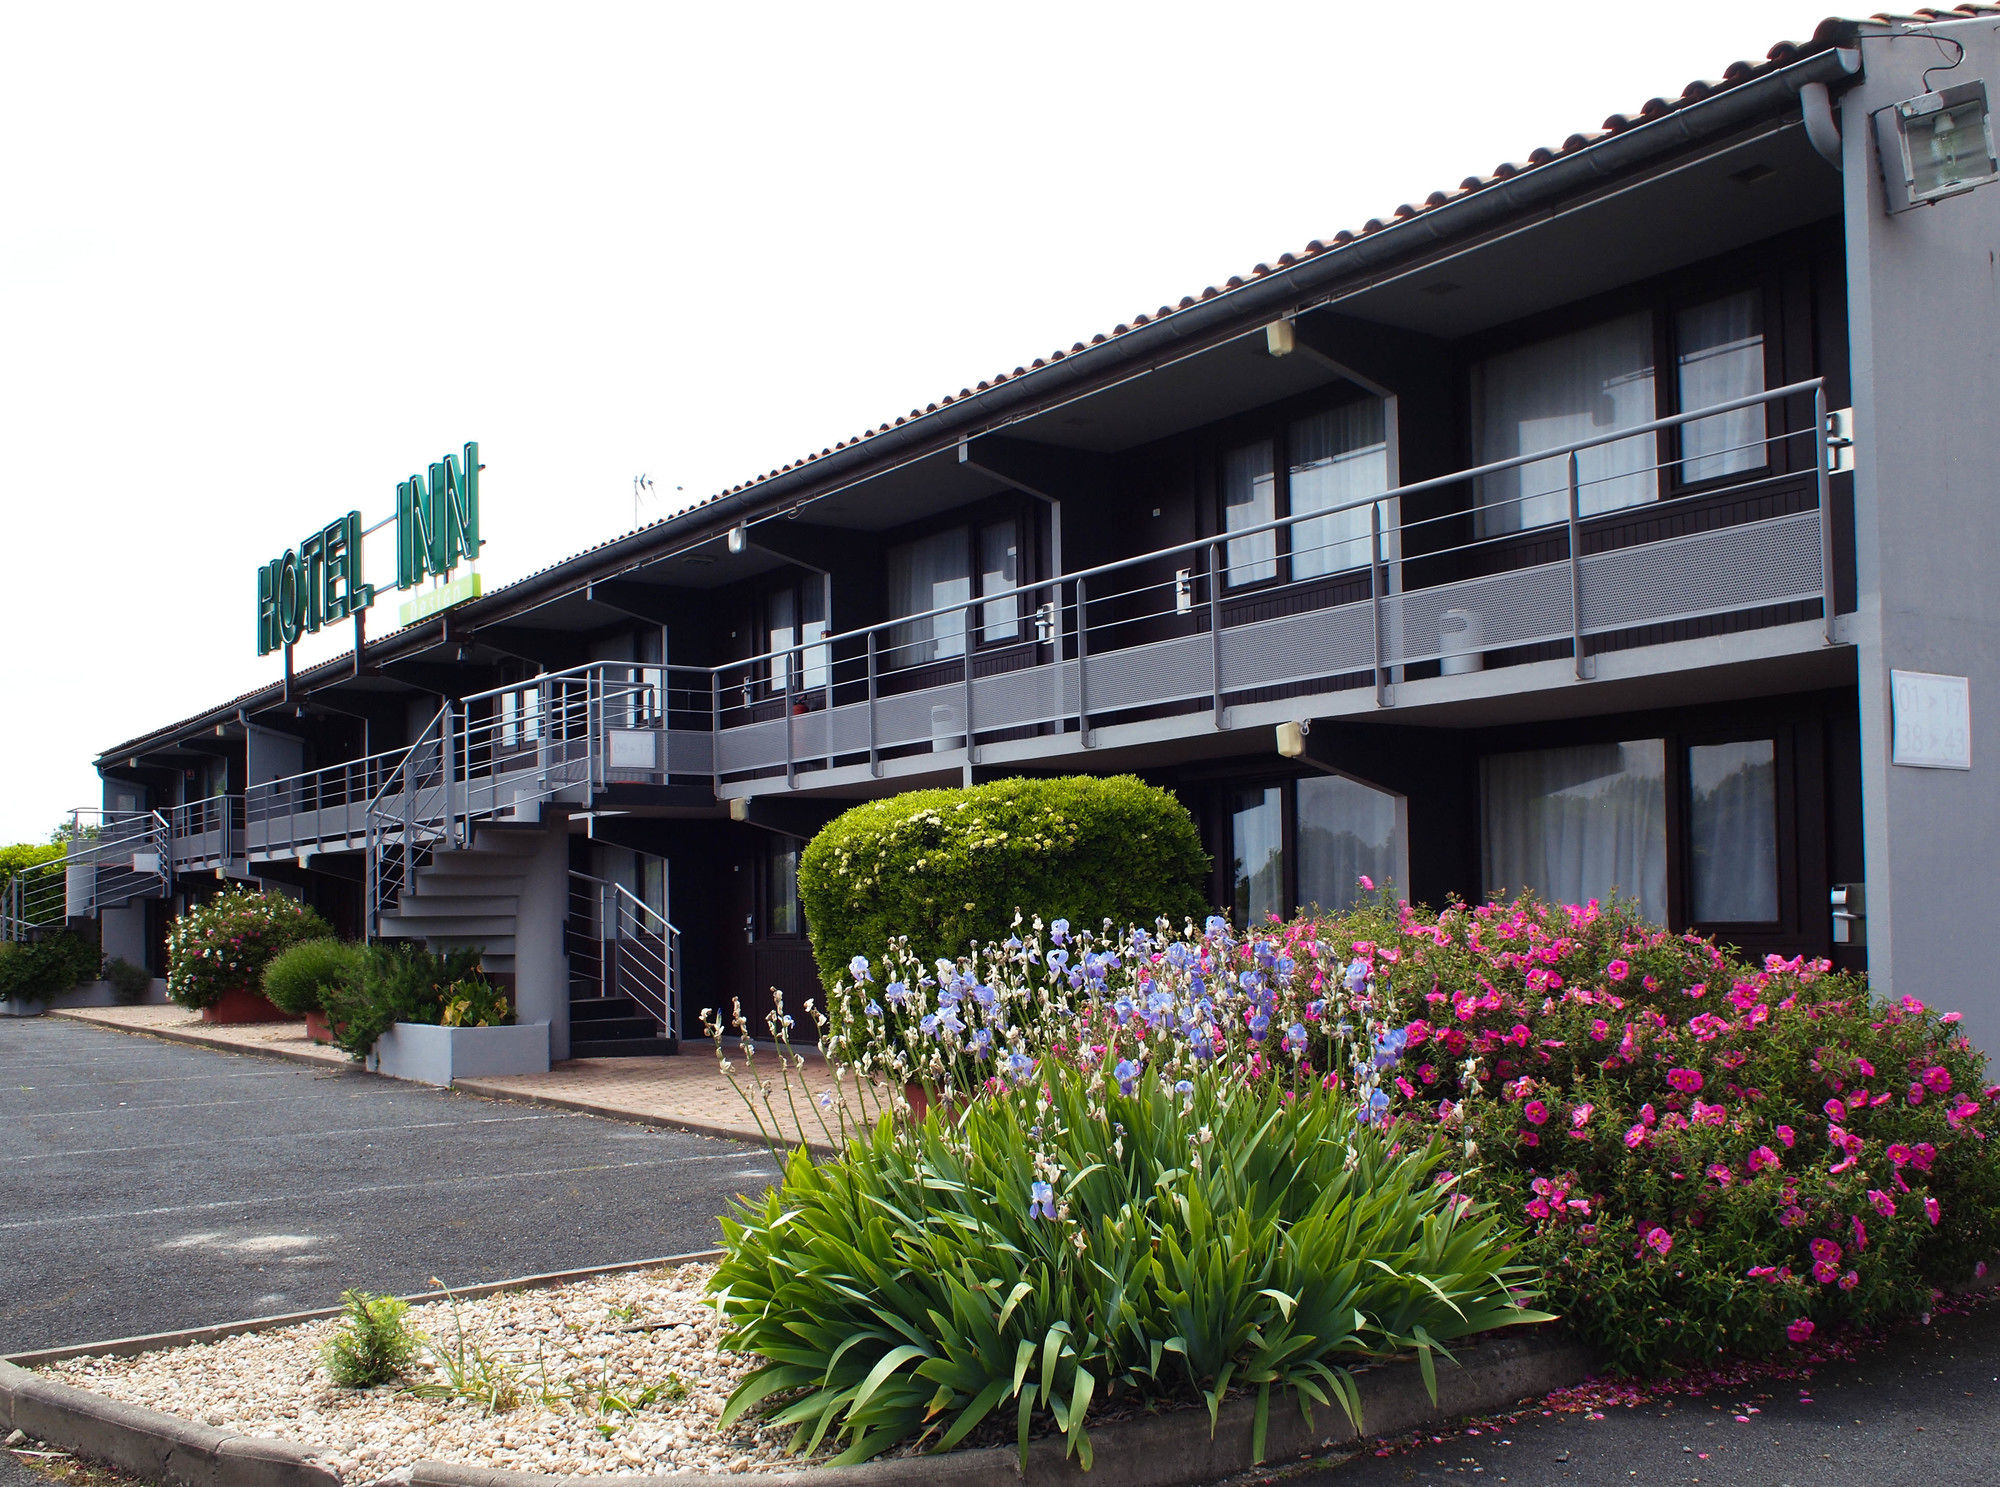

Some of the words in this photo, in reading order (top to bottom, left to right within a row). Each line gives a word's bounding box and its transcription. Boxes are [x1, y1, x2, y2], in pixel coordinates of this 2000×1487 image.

[258, 511, 374, 656] HOTEL
[397, 442, 478, 591] INN
[1899, 683, 1920, 713] 01
